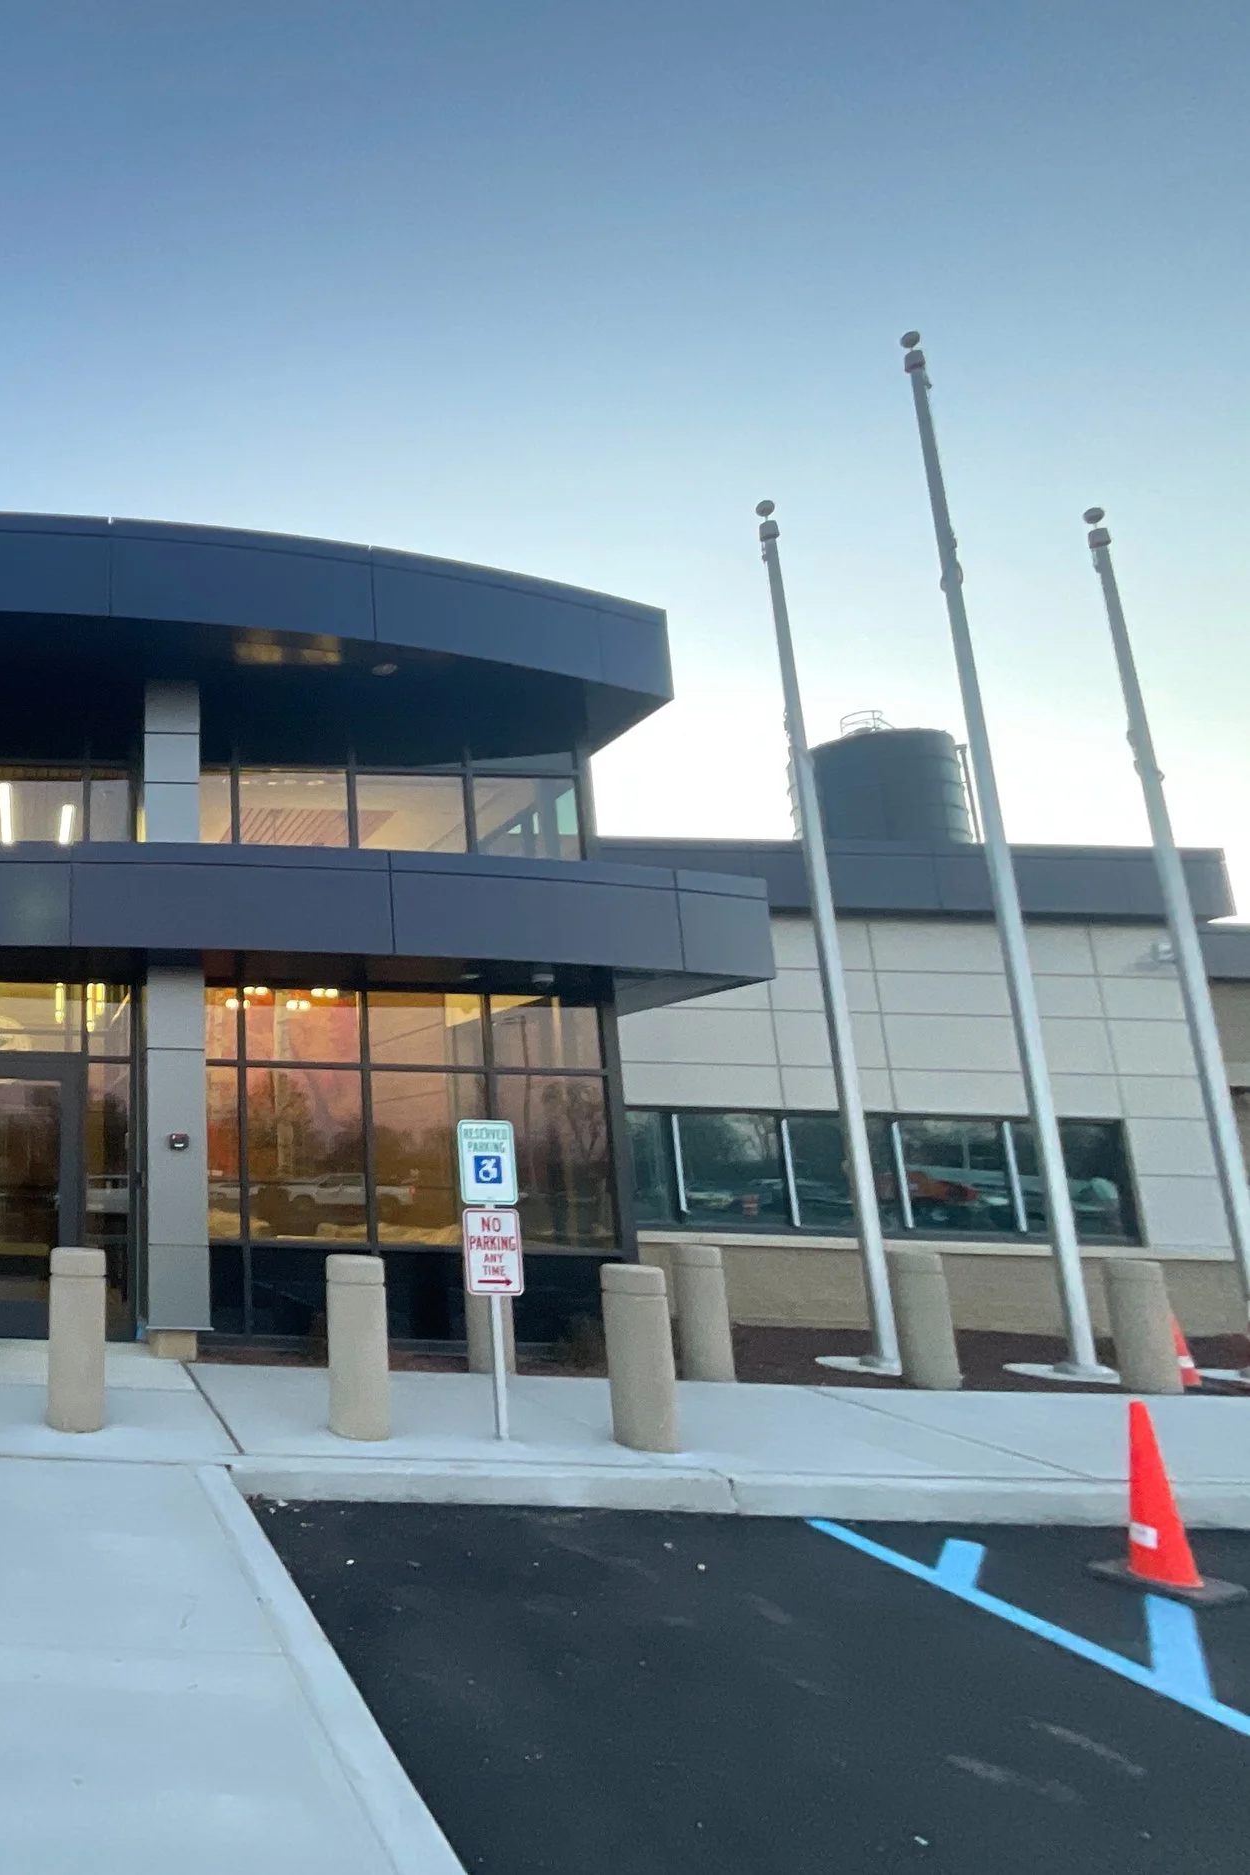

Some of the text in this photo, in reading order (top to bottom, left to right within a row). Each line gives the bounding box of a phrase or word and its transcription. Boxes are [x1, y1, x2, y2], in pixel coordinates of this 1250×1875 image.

[463, 1128, 508, 1140] RESERVED
[467, 1141, 505, 1153] PARKING
[481, 1217, 501, 1232] NO
[469, 1235, 516, 1251] PARKING
[484, 1253, 503, 1263] ANY
[483, 1265, 506, 1276] TIME
